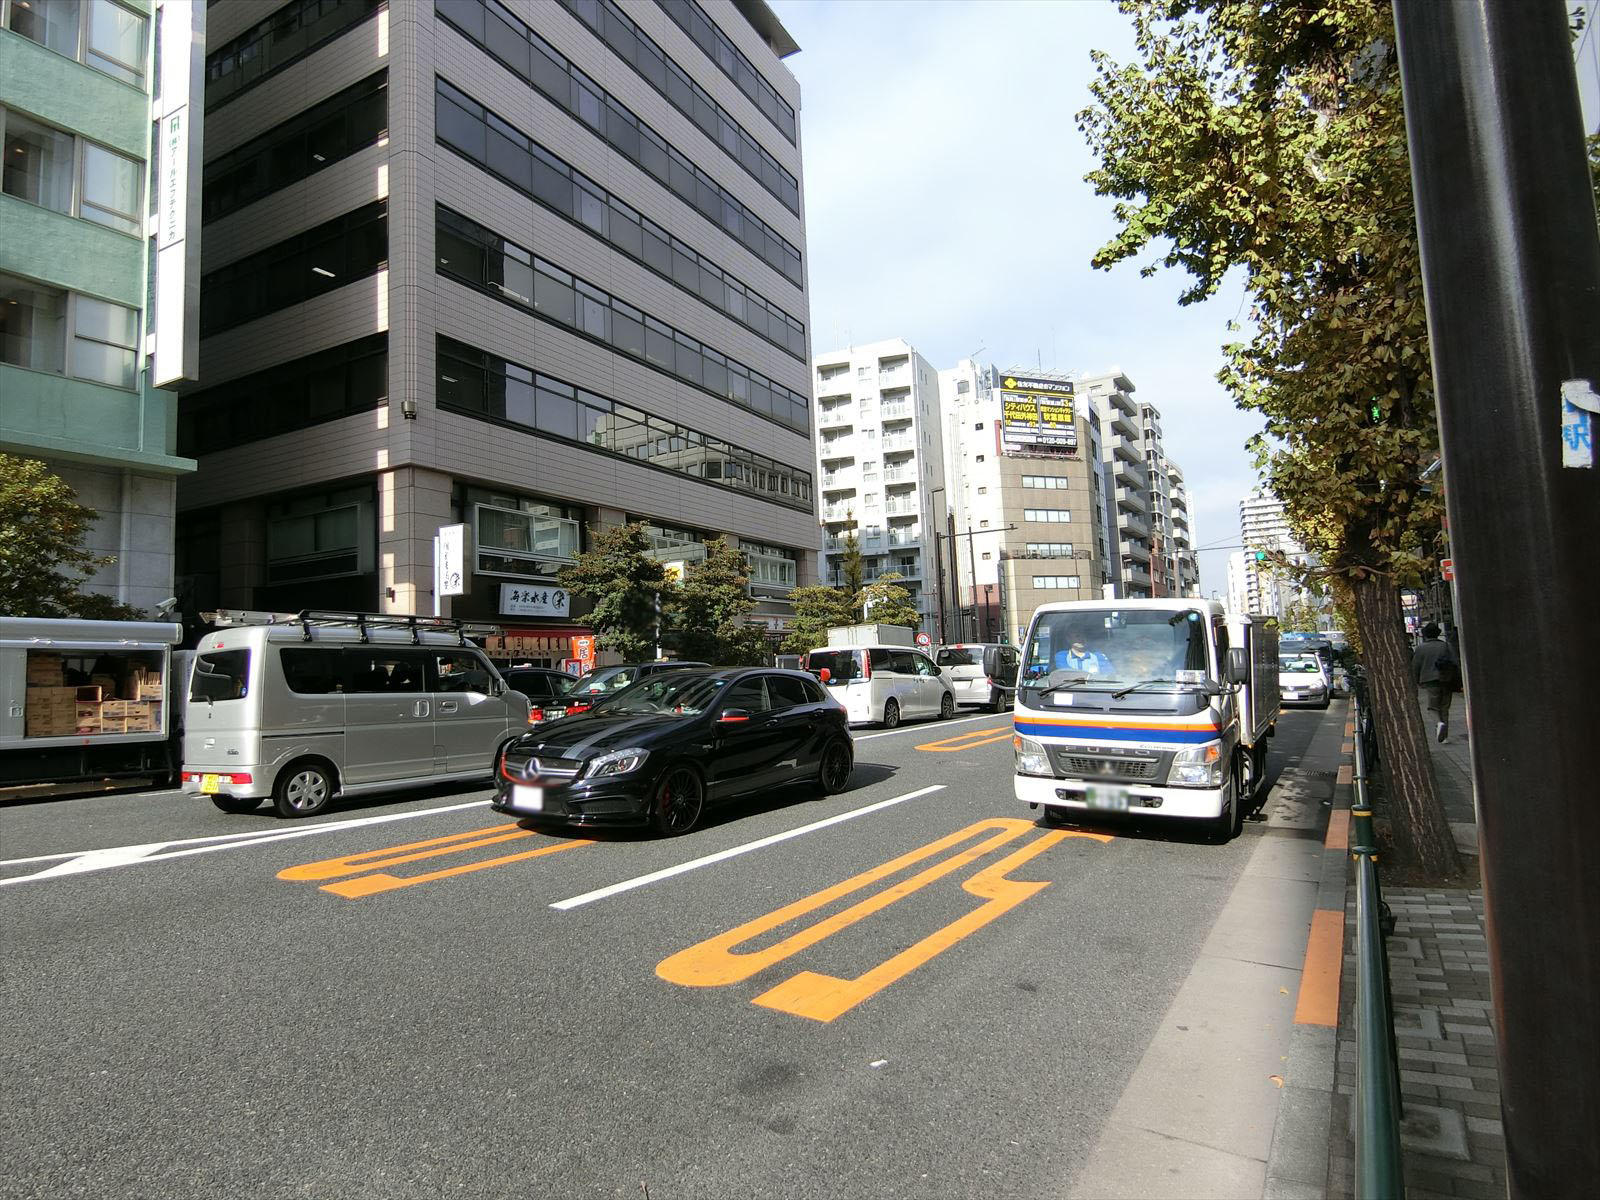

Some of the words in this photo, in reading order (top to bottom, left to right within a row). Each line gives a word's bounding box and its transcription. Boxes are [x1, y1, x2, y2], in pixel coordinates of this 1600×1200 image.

[1004, 403, 1036, 411] シティハウス
[1065, 745, 1150, 756] FUSO
